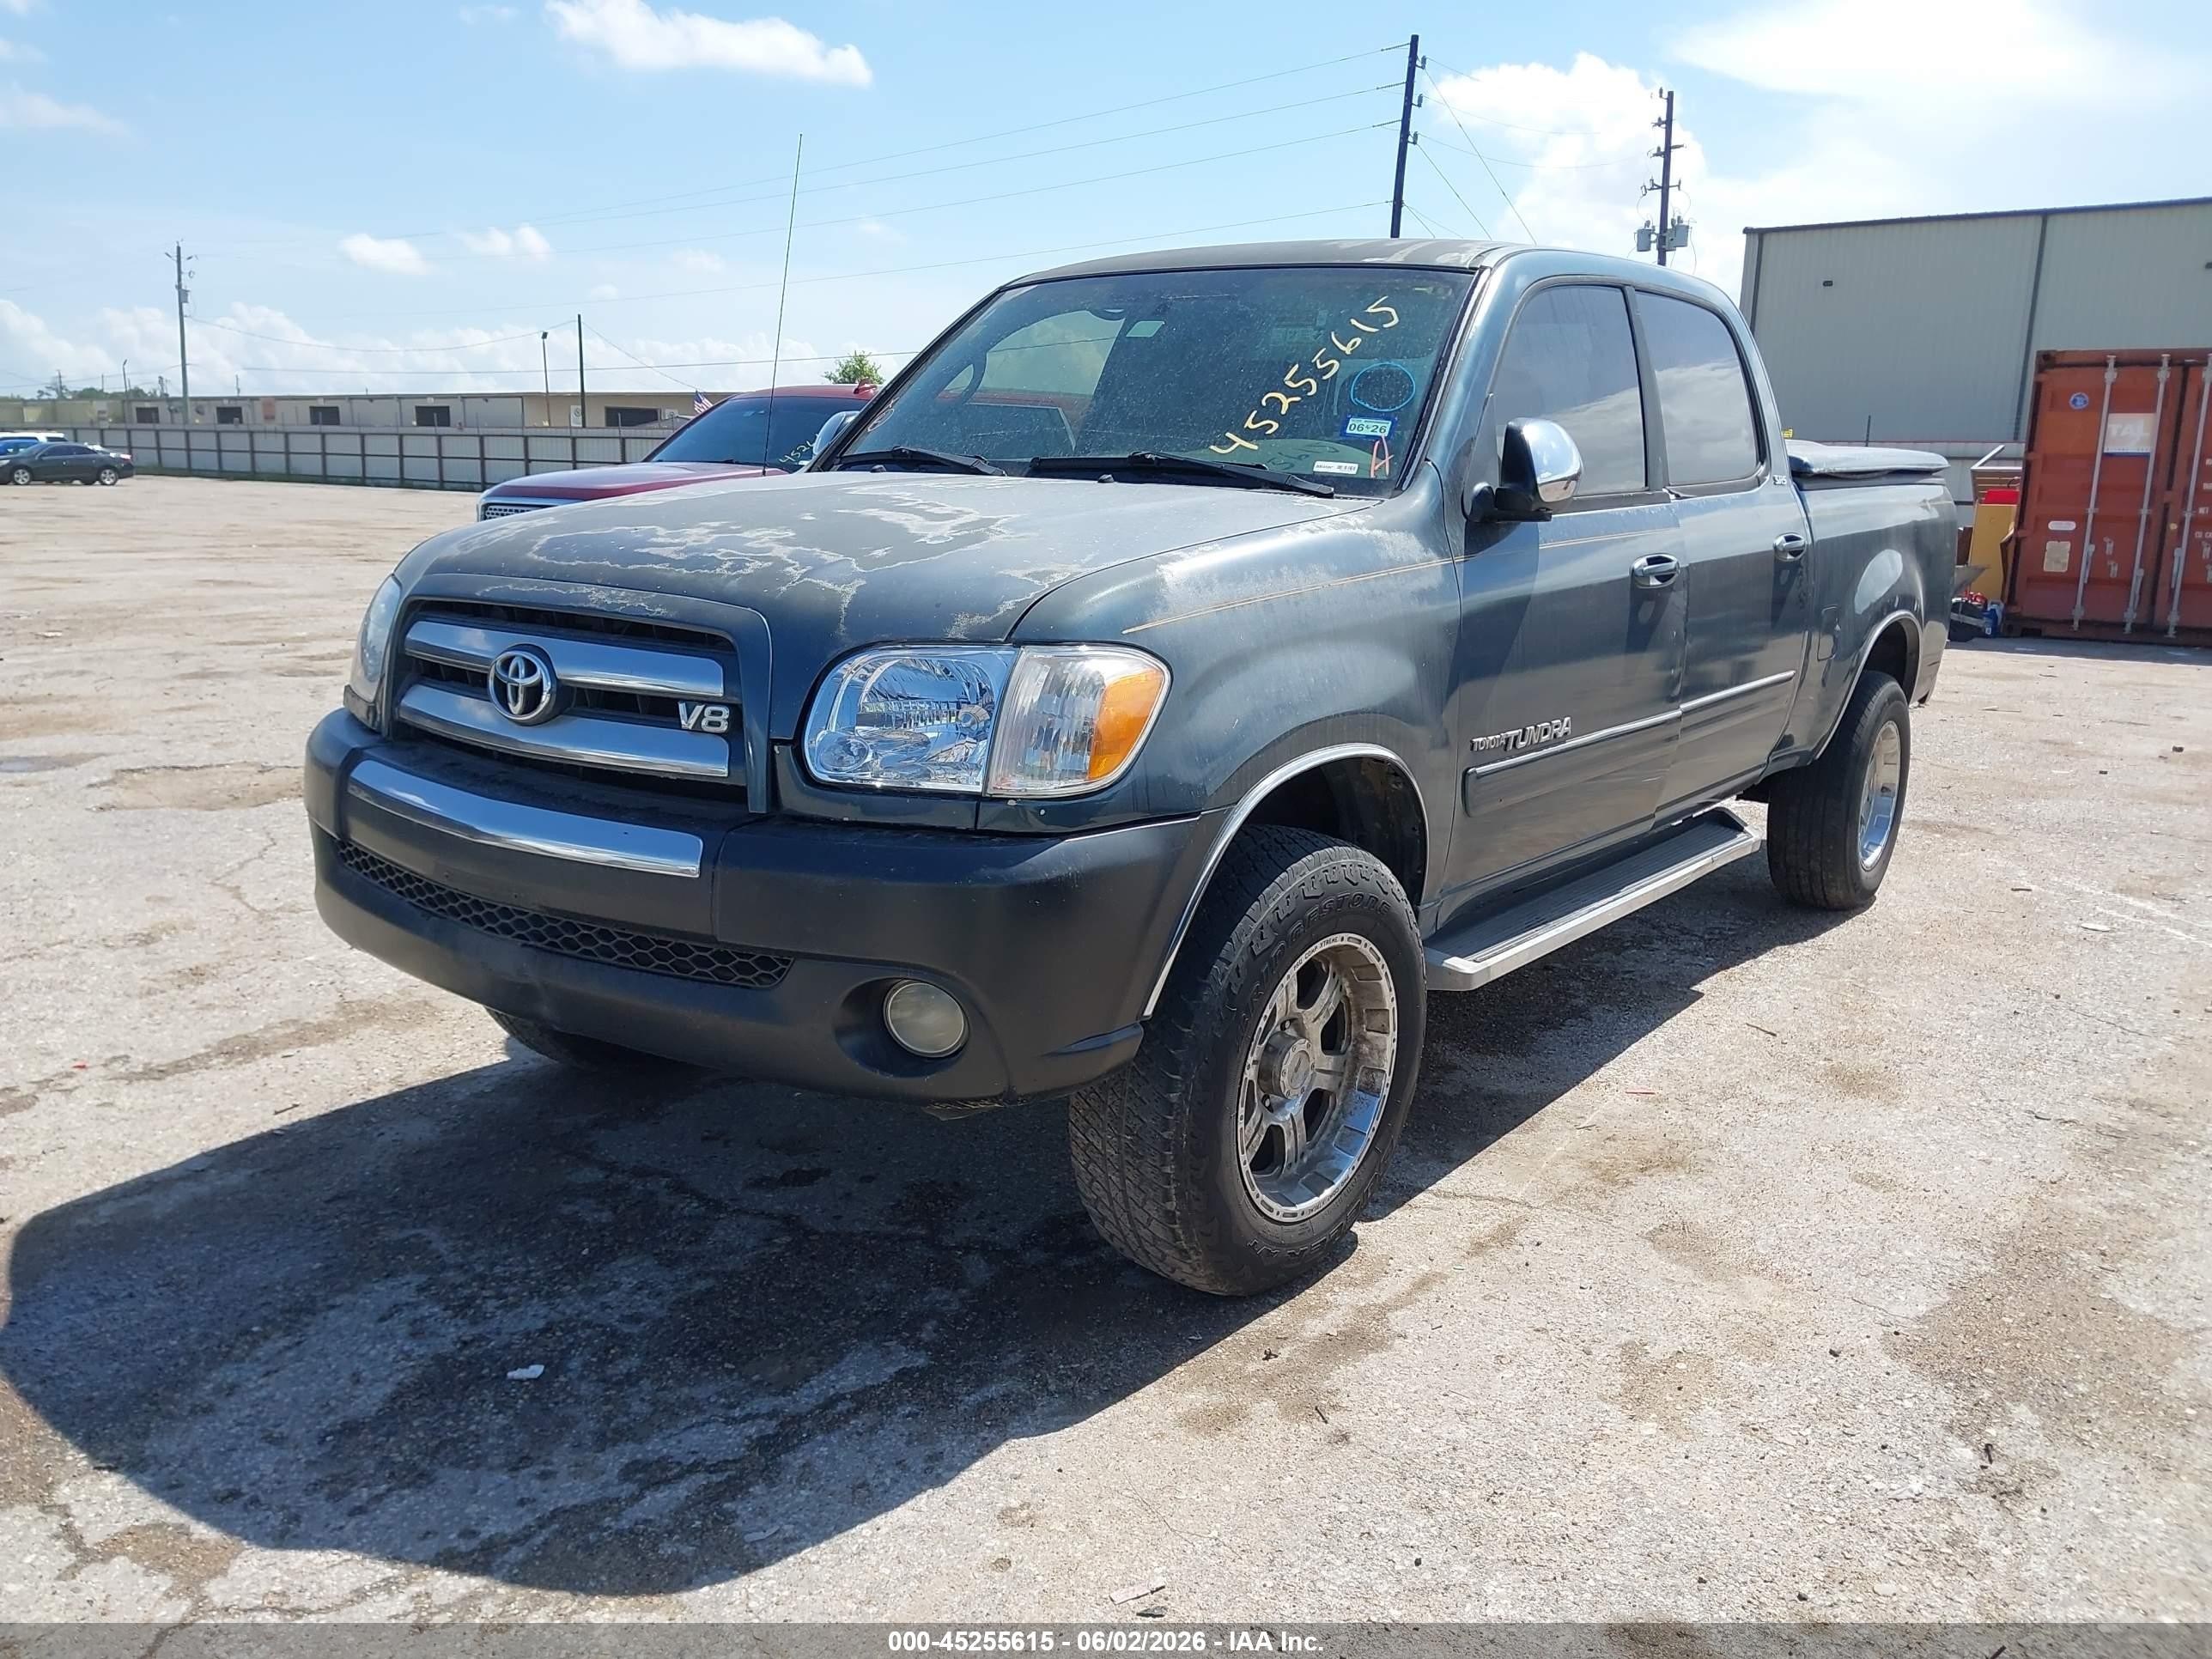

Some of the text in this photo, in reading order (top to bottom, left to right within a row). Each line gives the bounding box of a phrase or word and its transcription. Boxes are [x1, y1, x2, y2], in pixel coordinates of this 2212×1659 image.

[1210, 295, 1400, 453] 45255615
[1349, 422, 1388, 434] 06 26
[678, 701, 730, 733] V8
[1472, 716, 1571, 751] TOYOTA TUNDRA
